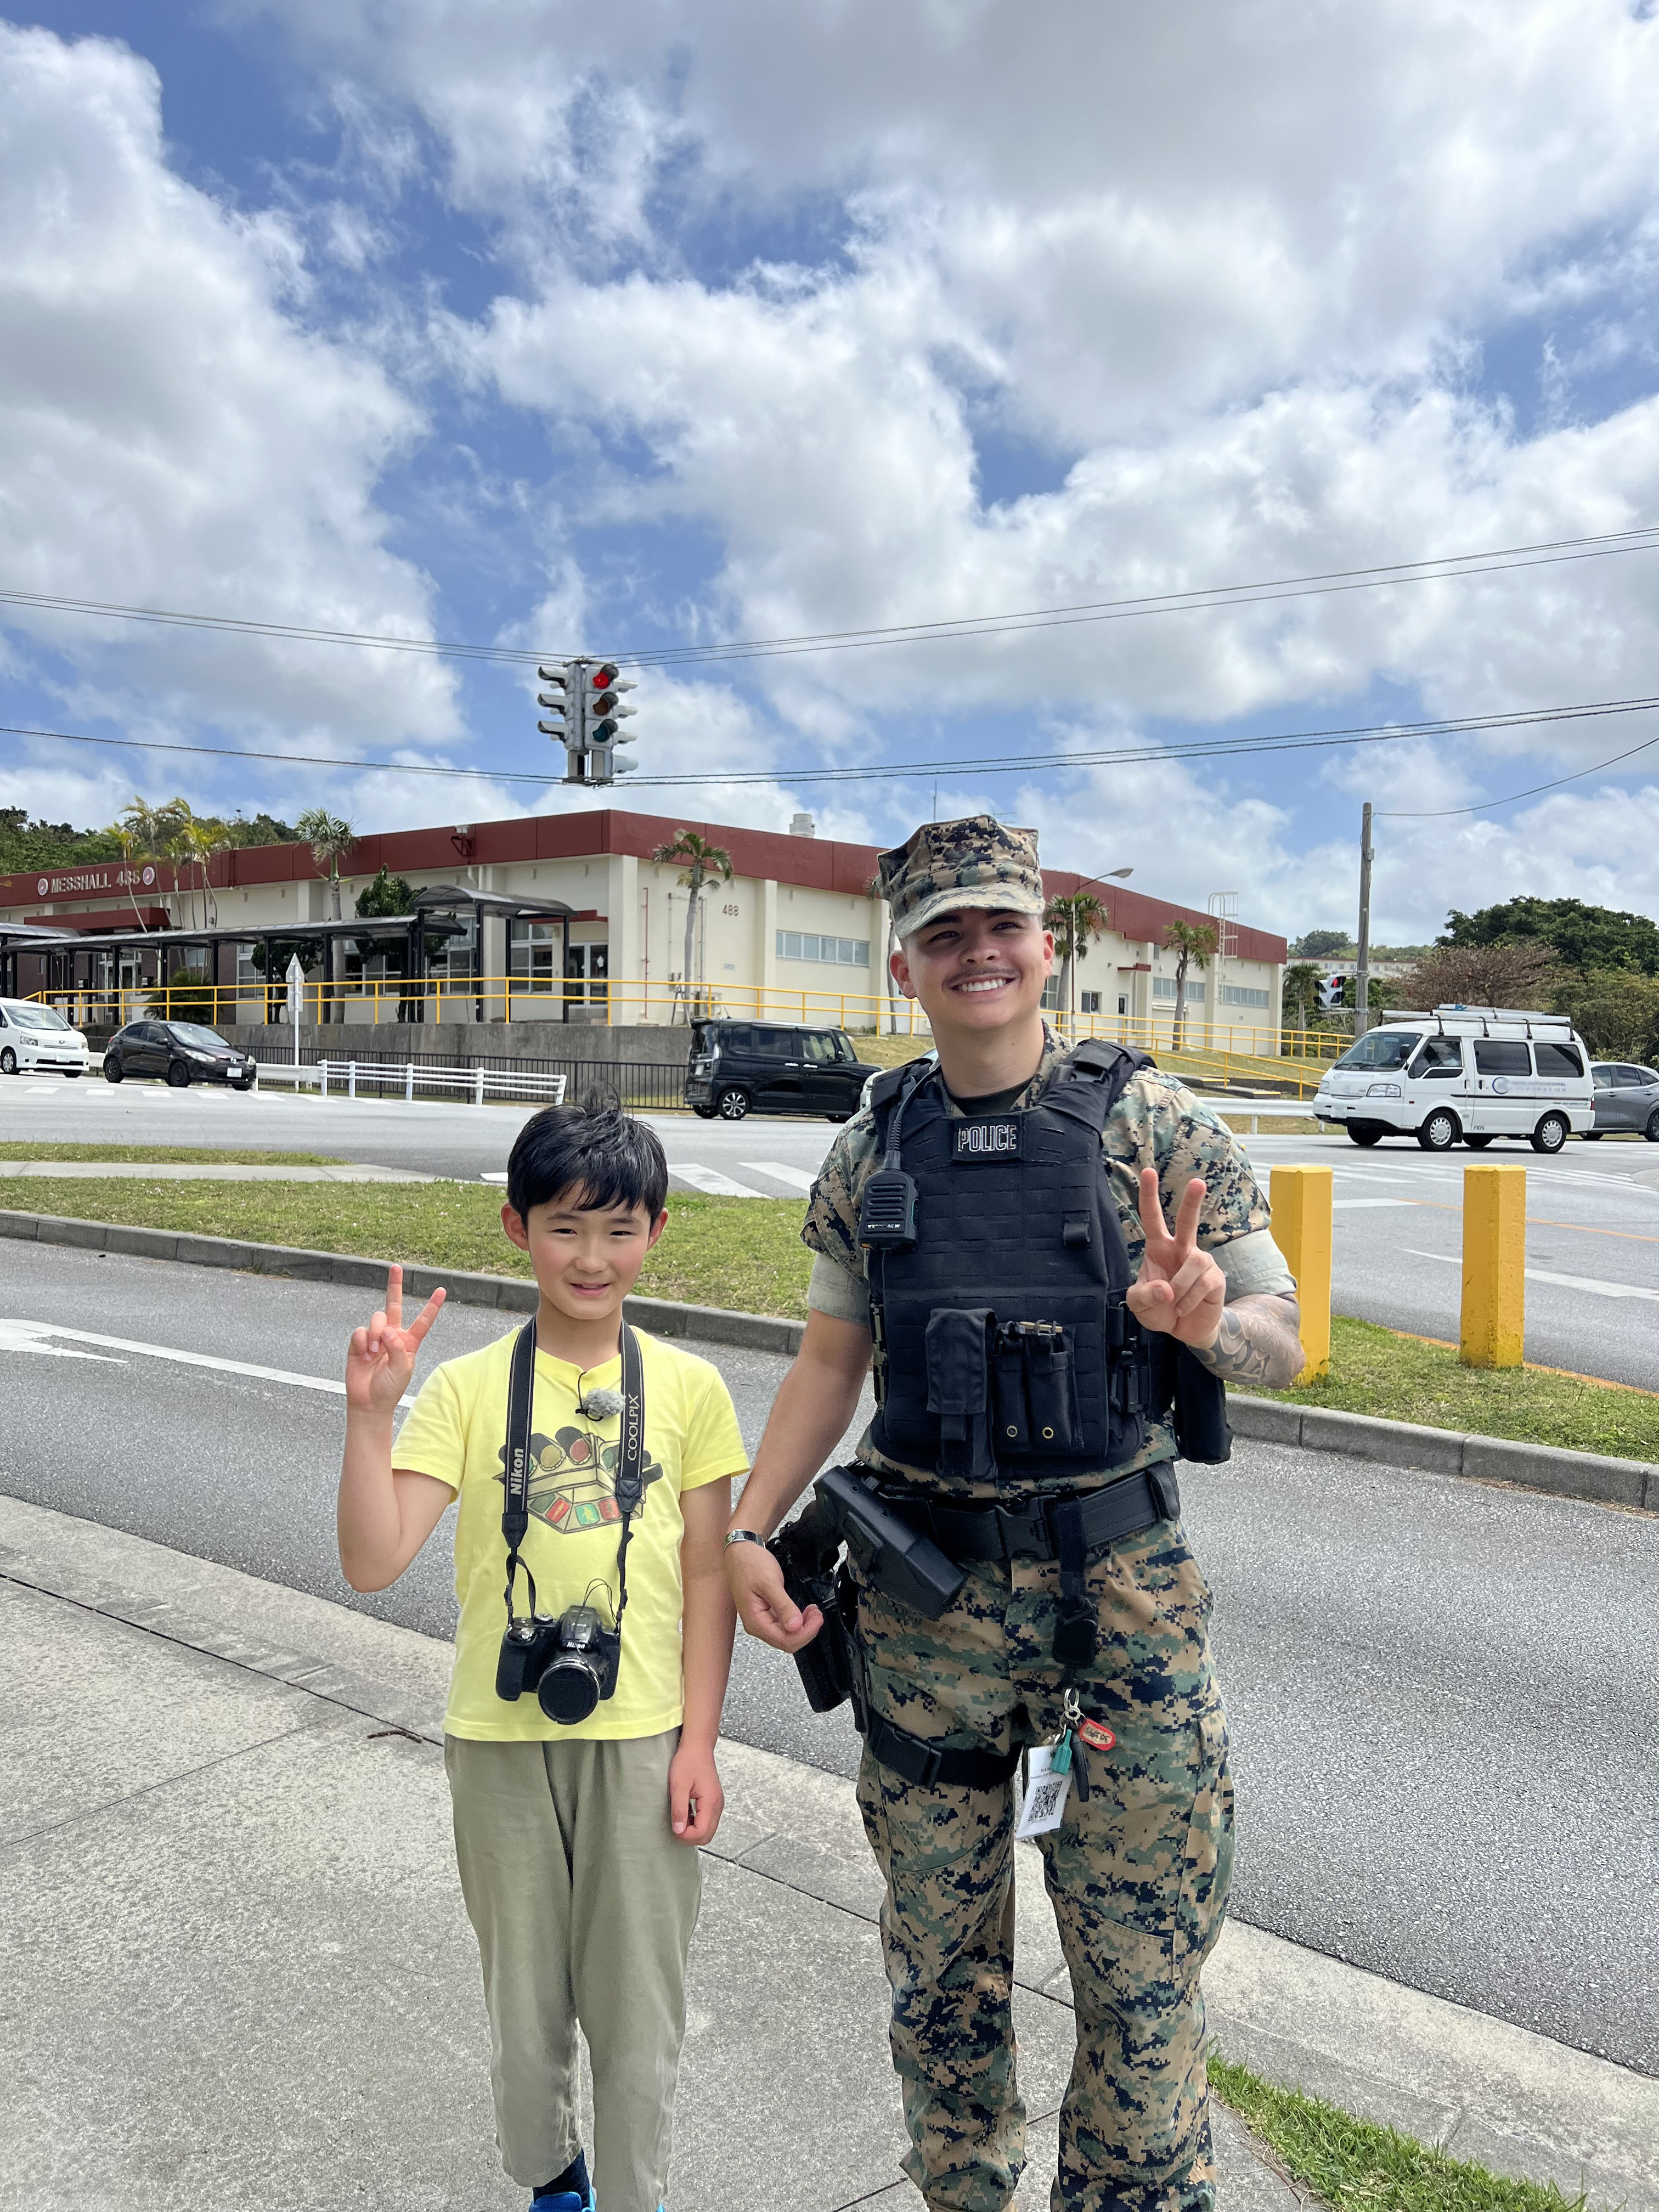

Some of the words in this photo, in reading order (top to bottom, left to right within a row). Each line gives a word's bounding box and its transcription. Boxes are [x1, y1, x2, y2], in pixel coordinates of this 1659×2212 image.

[50, 872, 112, 894] MESSHALL
[722, 904, 738, 916] 488
[957, 1125, 1017, 1152] POLICE
[627, 1393, 640, 1461] COOLPIX
[510, 1448, 524, 1495] Nikon
